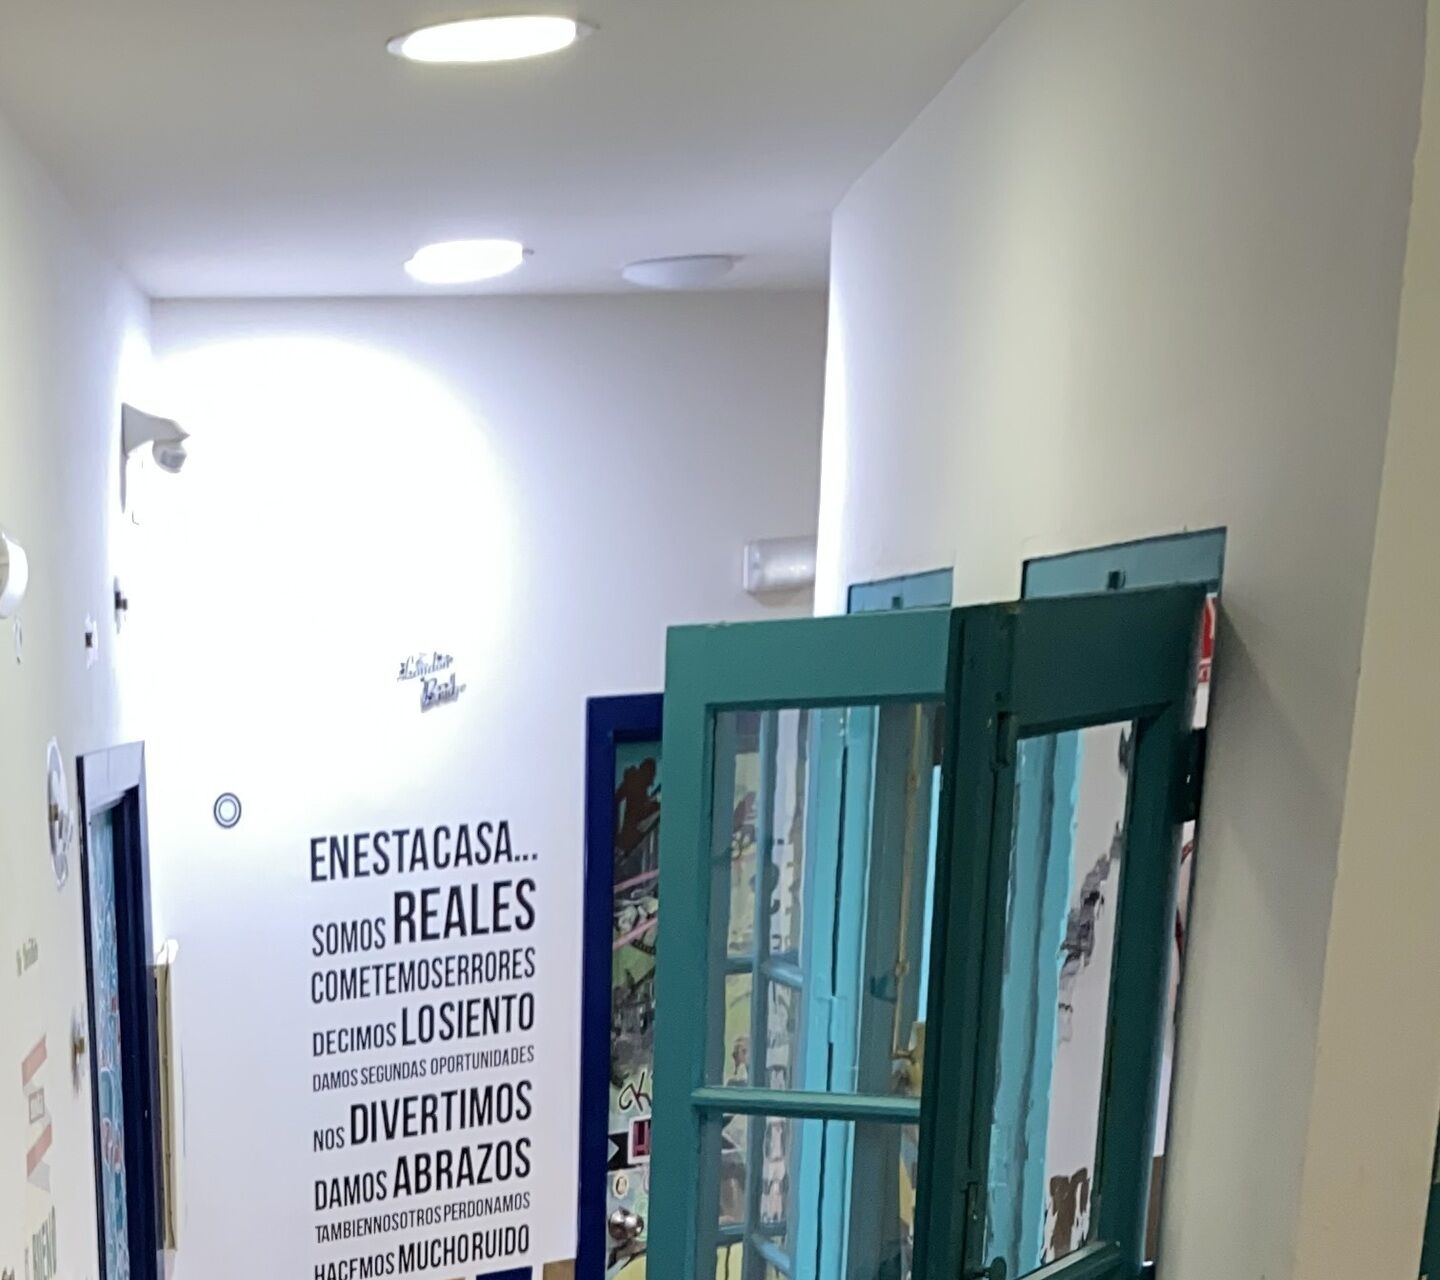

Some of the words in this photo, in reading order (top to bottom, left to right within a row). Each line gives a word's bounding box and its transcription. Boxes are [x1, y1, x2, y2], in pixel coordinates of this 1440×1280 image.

[312, 917, 386, 957] SOMOS
[393, 878, 537, 945] REALES
[312, 1021, 397, 1057] DECIMOS
[312, 1068, 359, 1093] DAMOS
[360, 1059, 427, 1086] SEGUNDAS
[430, 1045, 535, 1076] OPORTUNIDADES
[313, 1126, 345, 1153] NOS
[350, 1079, 533, 1146] DIVERTIMOS
[314, 1169, 388, 1211] DAMOS
[392, 1137, 532, 1198] ABRAZOS
[443, 1191, 531, 1223] PERDONAMOS
